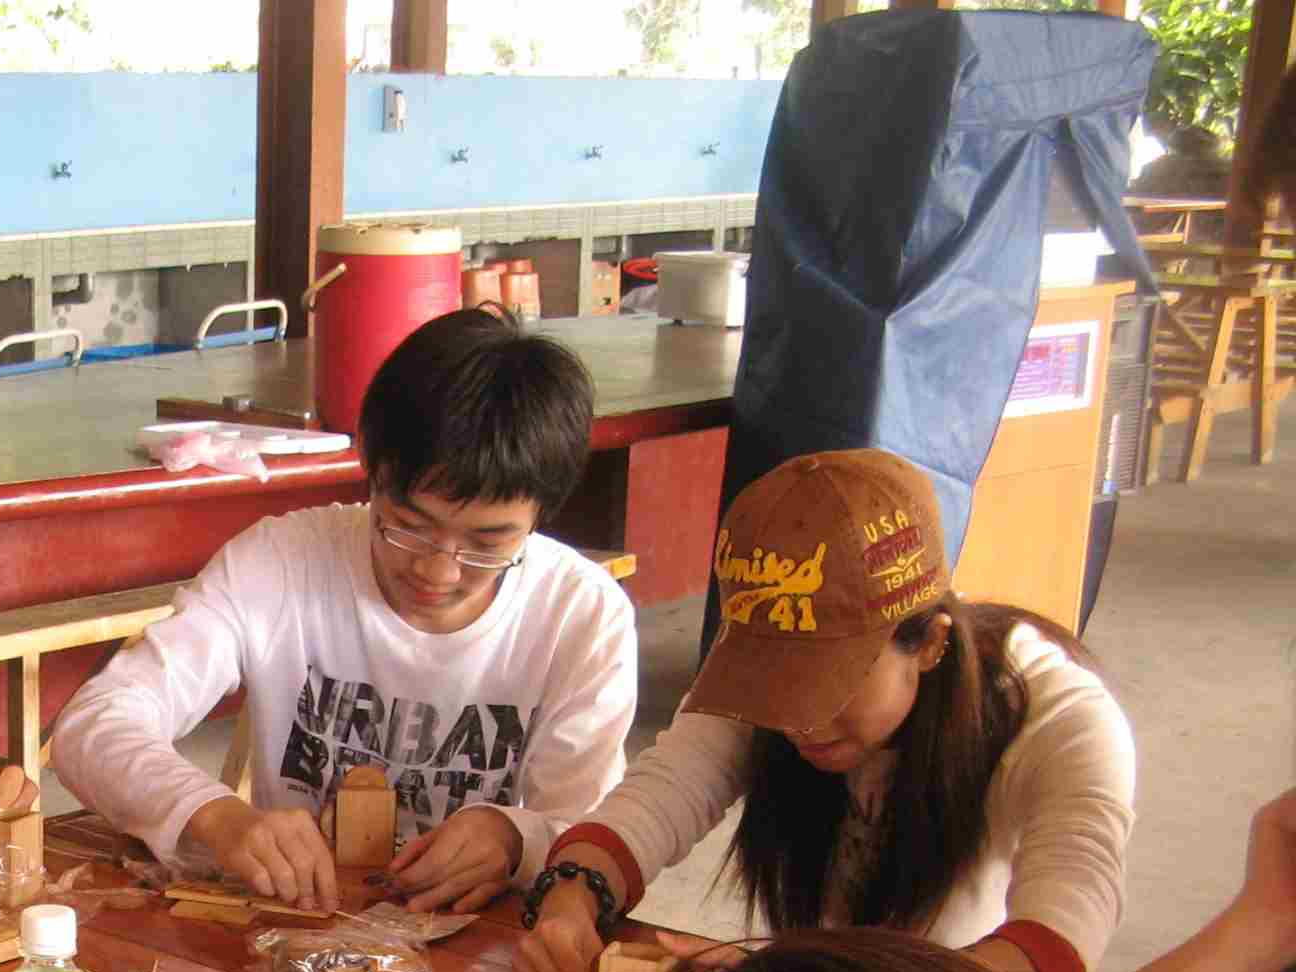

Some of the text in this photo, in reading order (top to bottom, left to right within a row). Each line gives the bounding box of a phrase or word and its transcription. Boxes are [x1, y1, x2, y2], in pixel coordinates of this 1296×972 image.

[864, 509, 909, 544] USA
[715, 528, 826, 594] United
[885, 560, 923, 592] 1941
[768, 595, 816, 632] 41
[880, 582, 937, 620] VILLAGE
